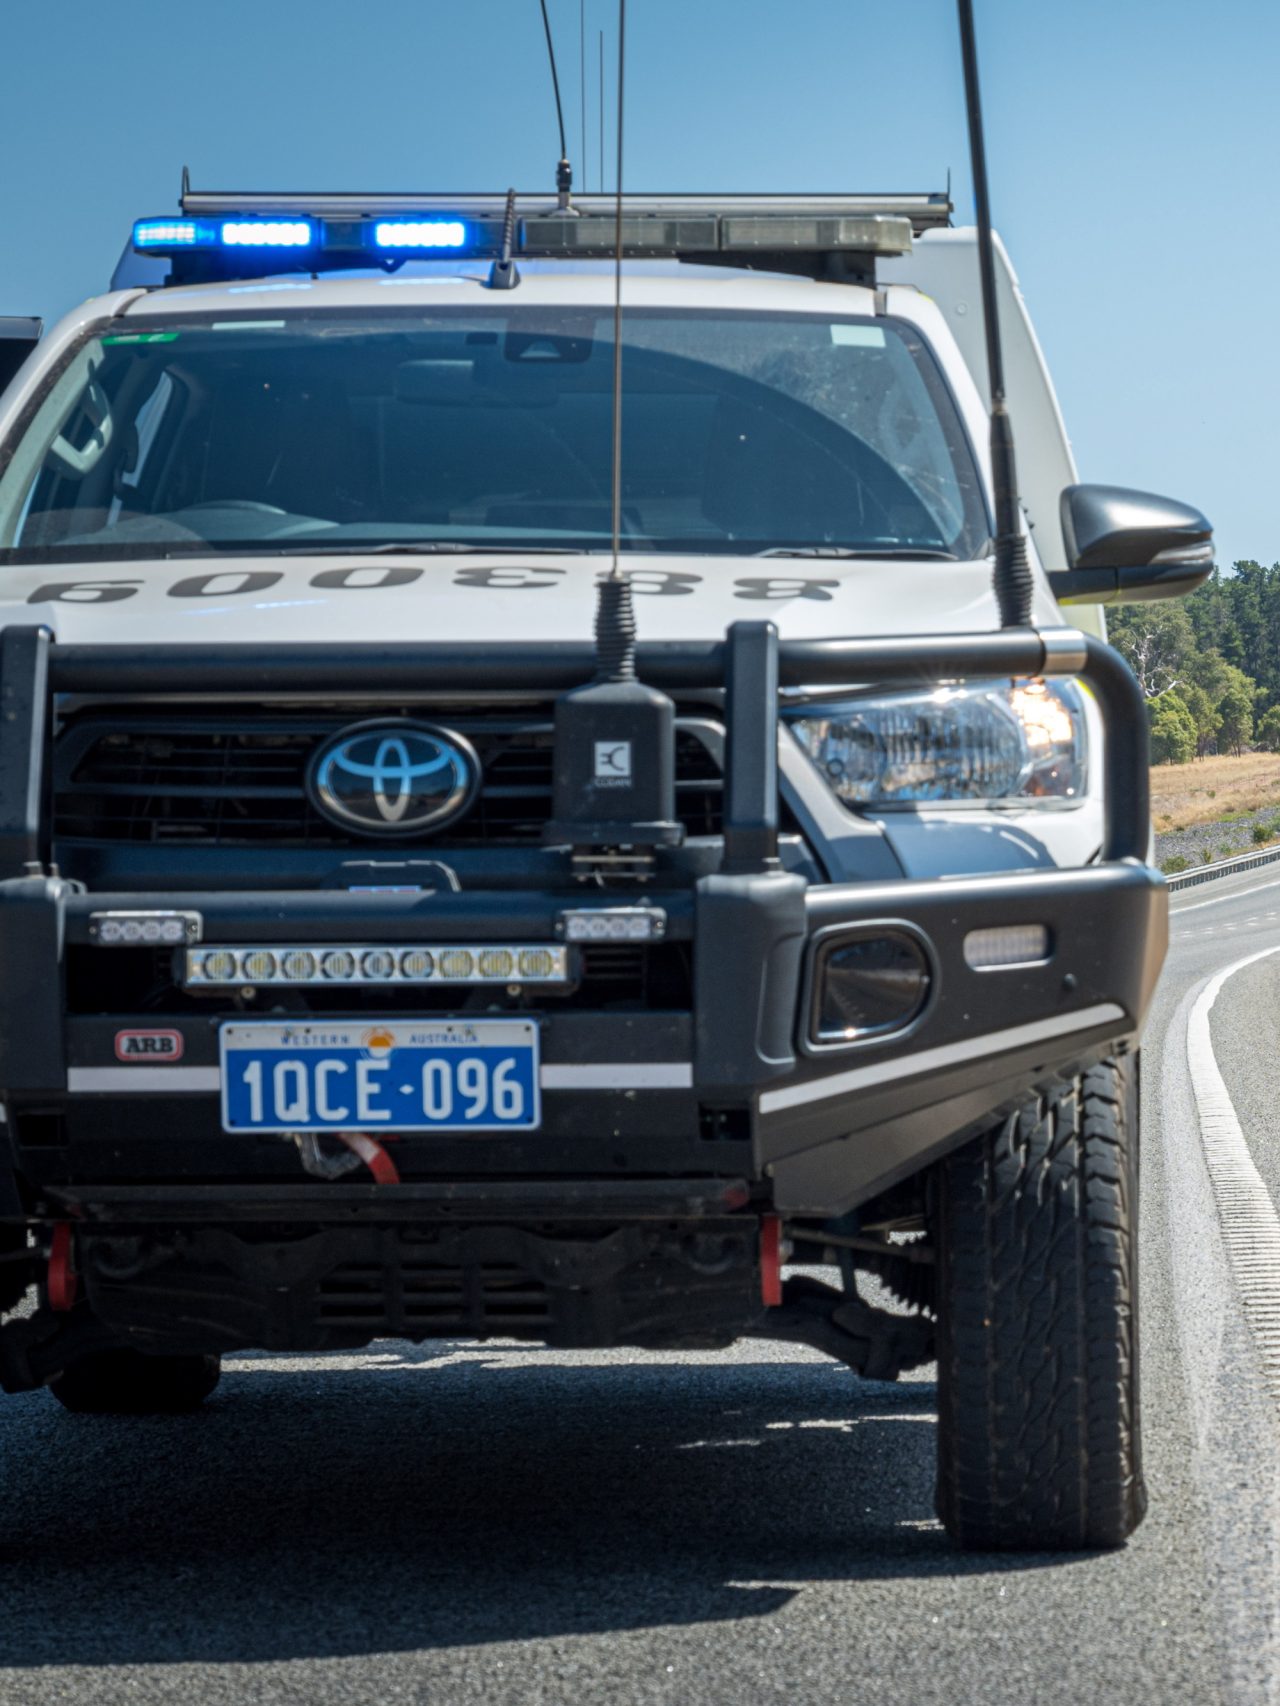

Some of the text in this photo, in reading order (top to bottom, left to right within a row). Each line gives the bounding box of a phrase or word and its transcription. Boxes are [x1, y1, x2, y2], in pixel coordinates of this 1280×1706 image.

[125, 1036, 174, 1054] ARB
[280, 1032, 479, 1046] WESTERN AUSTRALIA
